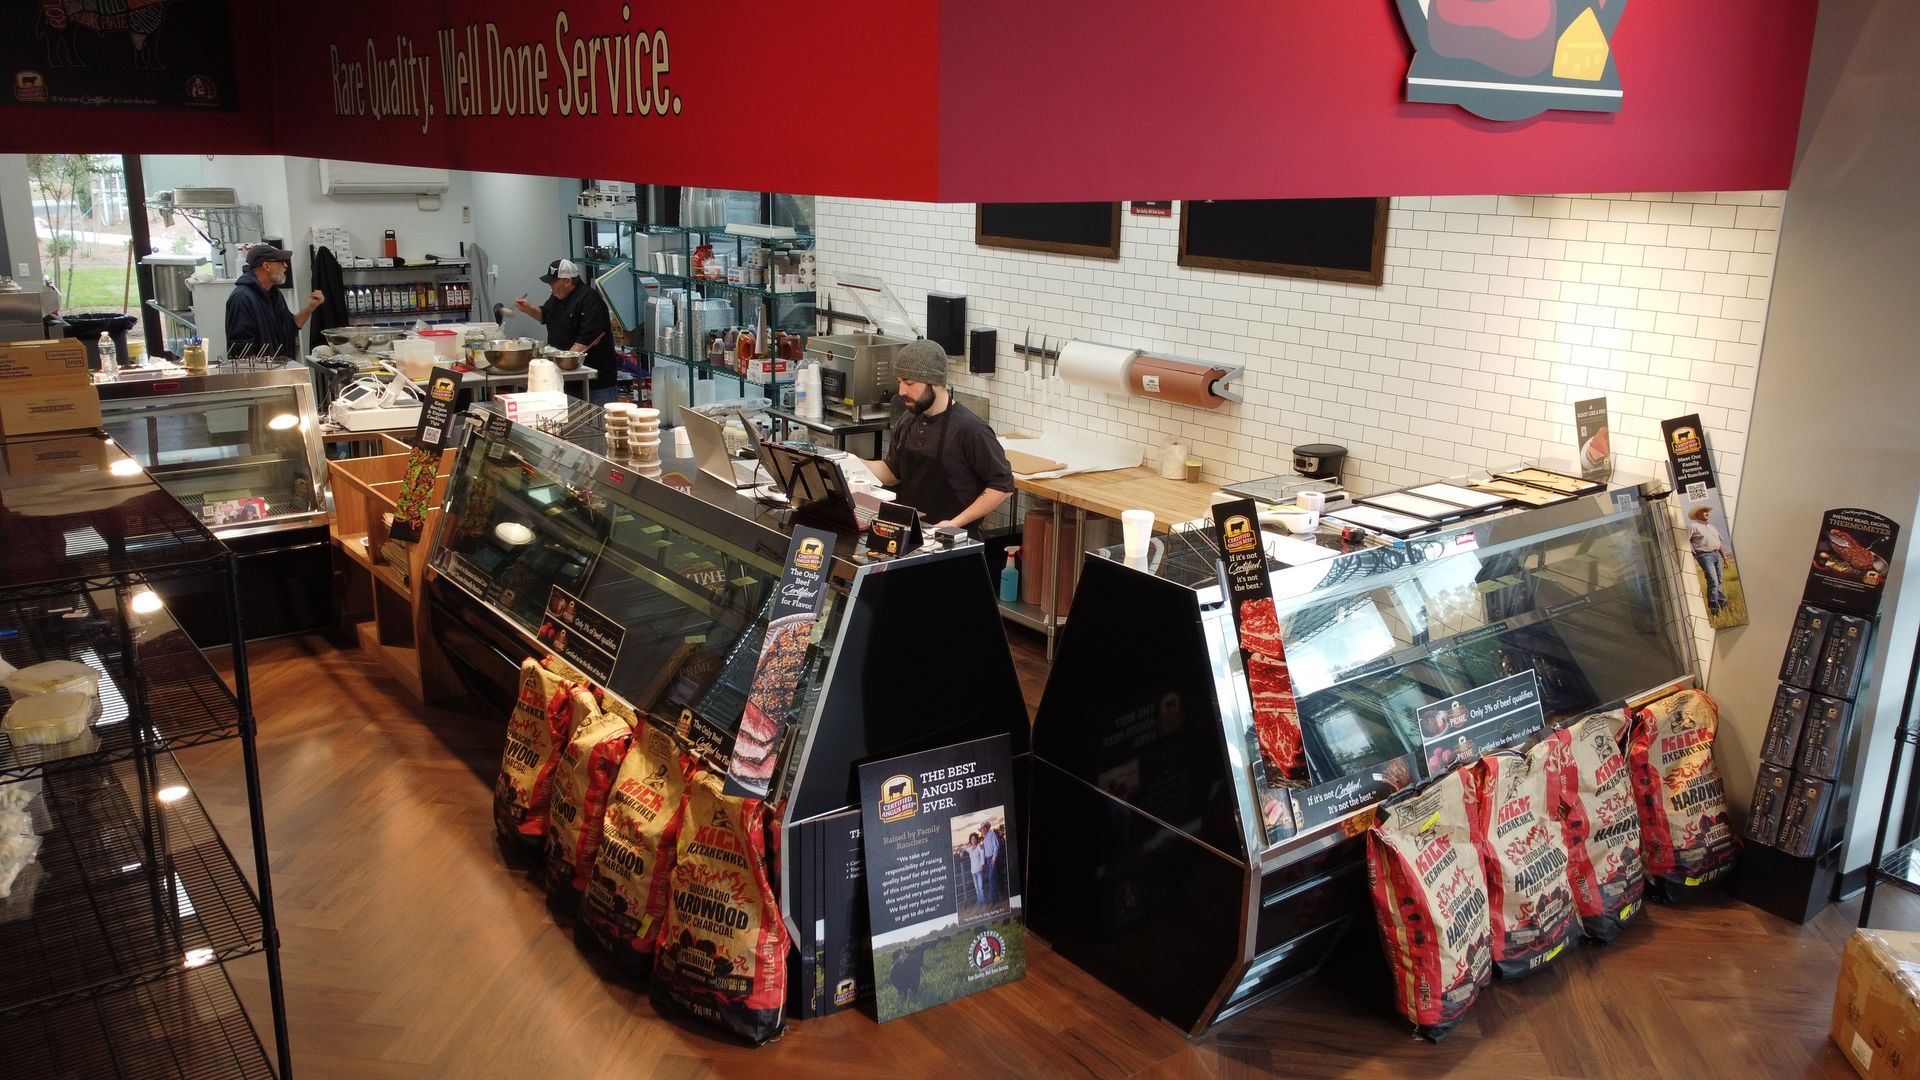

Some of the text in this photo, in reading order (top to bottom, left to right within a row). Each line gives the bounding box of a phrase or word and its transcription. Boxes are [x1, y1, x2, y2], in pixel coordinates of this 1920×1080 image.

[330, 4, 683, 135] Rare Quality. Well Done Service.
[429, 405, 448, 415] Recipes
[434, 400, 446, 409] Easy
[427, 415, 446, 424] Cooking
[1688, 471, 1709, 479] Ranchers
[1829, 518, 1891, 536] THERMOMETER
[1833, 514, 1854, 522] INSTANT
[1870, 521, 1890, 529] DIGITAL
[790, 568, 819, 582] The Only
[795, 577, 810, 587] Beef
[1236, 575, 1246, 583] it's
[781, 584, 818, 600] Certified
[1234, 583, 1245, 592] the
[781, 597, 812, 610] for Flavor
[572, 617, 586, 630] Only
[592, 628, 603, 640] beef
[598, 633, 619, 652] qualifies
[1469, 689, 1534, 719] Only 3% of beef qualifies
[1449, 714, 1467, 726] PRIME
[690, 718, 724, 744] The Only Beef
[1477, 741, 1496, 753] Certified
[1504, 734, 1512, 742] the
[1511, 731, 1521, 740] Best
[505, 740, 540, 769] WOOD
[920, 762, 976, 784] THE BEST
[921, 772, 996, 799] ANGUS BEEF.
[883, 796, 912, 811] CERTIFIED
[923, 797, 957, 813] EVER.
[1307, 790, 1335, 806] If it's not
[1328, 796, 1359, 815] It's not the
[882, 806, 902, 818] ANGUS
[1685, 803, 1703, 817] LUMP
[883, 825, 940, 845] Raised by Family
[1605, 834, 1626, 848] LUMP
[896, 838, 928, 850] Ranchers
[909, 852, 920, 860] take
[885, 863, 918, 876] responsibility
[926, 857, 943, 865] raising
[1514, 847, 1568, 893] HARDWOOD
[882, 878, 900, 887] quality
[900, 872, 912, 882] beef
[912, 871, 920, 879] for
[930, 865, 947, 875] people
[900, 882, 920, 892] country
[921, 878, 930, 886] and
[931, 875, 947, 883] across
[885, 897, 895, 905] this
[896, 892, 911, 902] world
[912, 890, 922, 899] very
[1525, 881, 1542, 898] LUMP
[899, 902, 908, 911] feel
[909, 900, 919, 908] very
[920, 894, 944, 905] fortunate
[677, 911, 735, 939] UMP CHARCOAL
[902, 913, 910, 921] get
[1446, 887, 1486, 949] HARDWOOD
[1455, 933, 1471, 953] LUMP
[681, 949, 712, 969] PREMIUM
